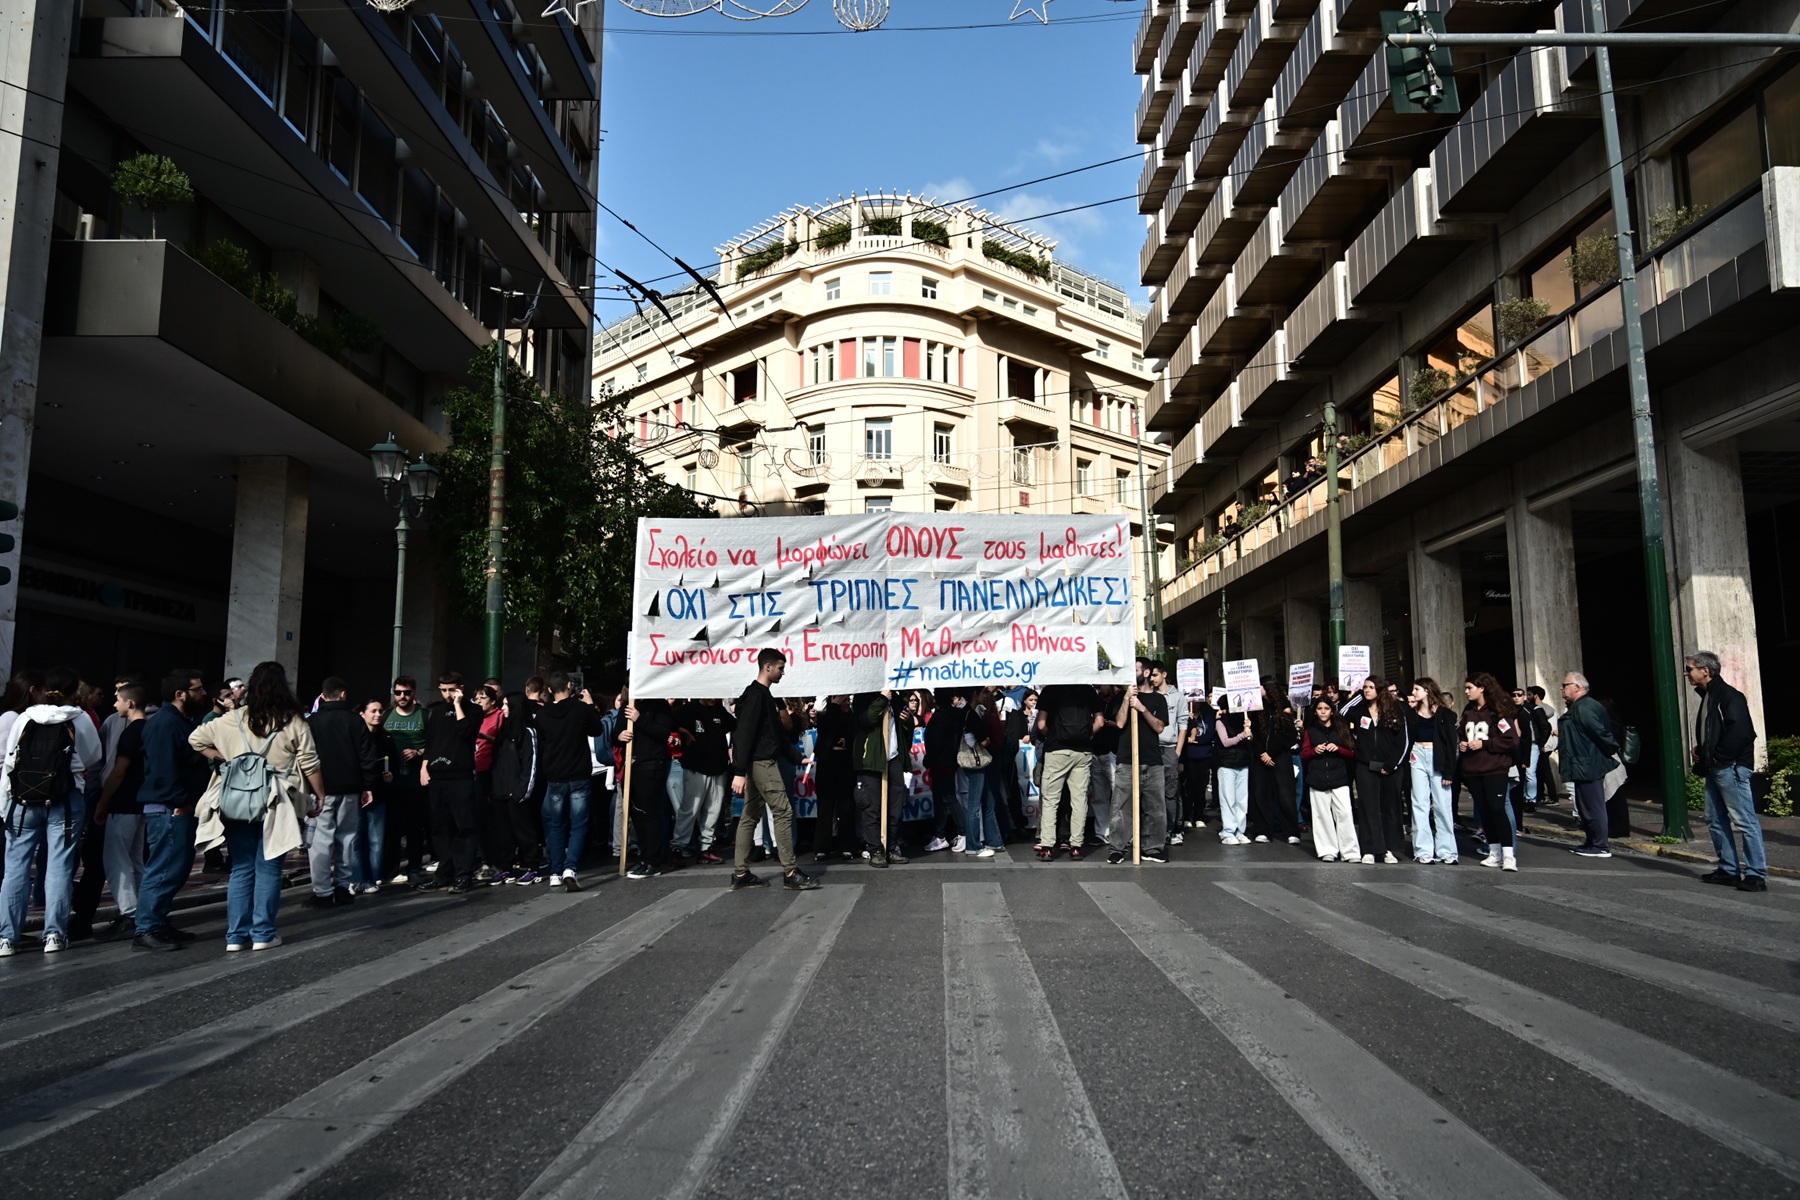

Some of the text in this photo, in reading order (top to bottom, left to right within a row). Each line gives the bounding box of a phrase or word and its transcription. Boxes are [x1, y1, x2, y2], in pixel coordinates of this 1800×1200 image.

[648, 523, 1123, 571] Σχολείο να μορφώνει ΟΛΟΥΣ τους μαθητές!
[666, 588, 708, 620] ΟΧΙ
[728, 591, 786, 619] ΣΤΙΣ
[808, 578, 919, 613] ΤΡΙΠΛΕΣ
[649, 623, 1086, 666] Συντονιστή Επιτροπή Μαθητών Αθήνας
[888, 658, 1041, 688] #mathites.gr
